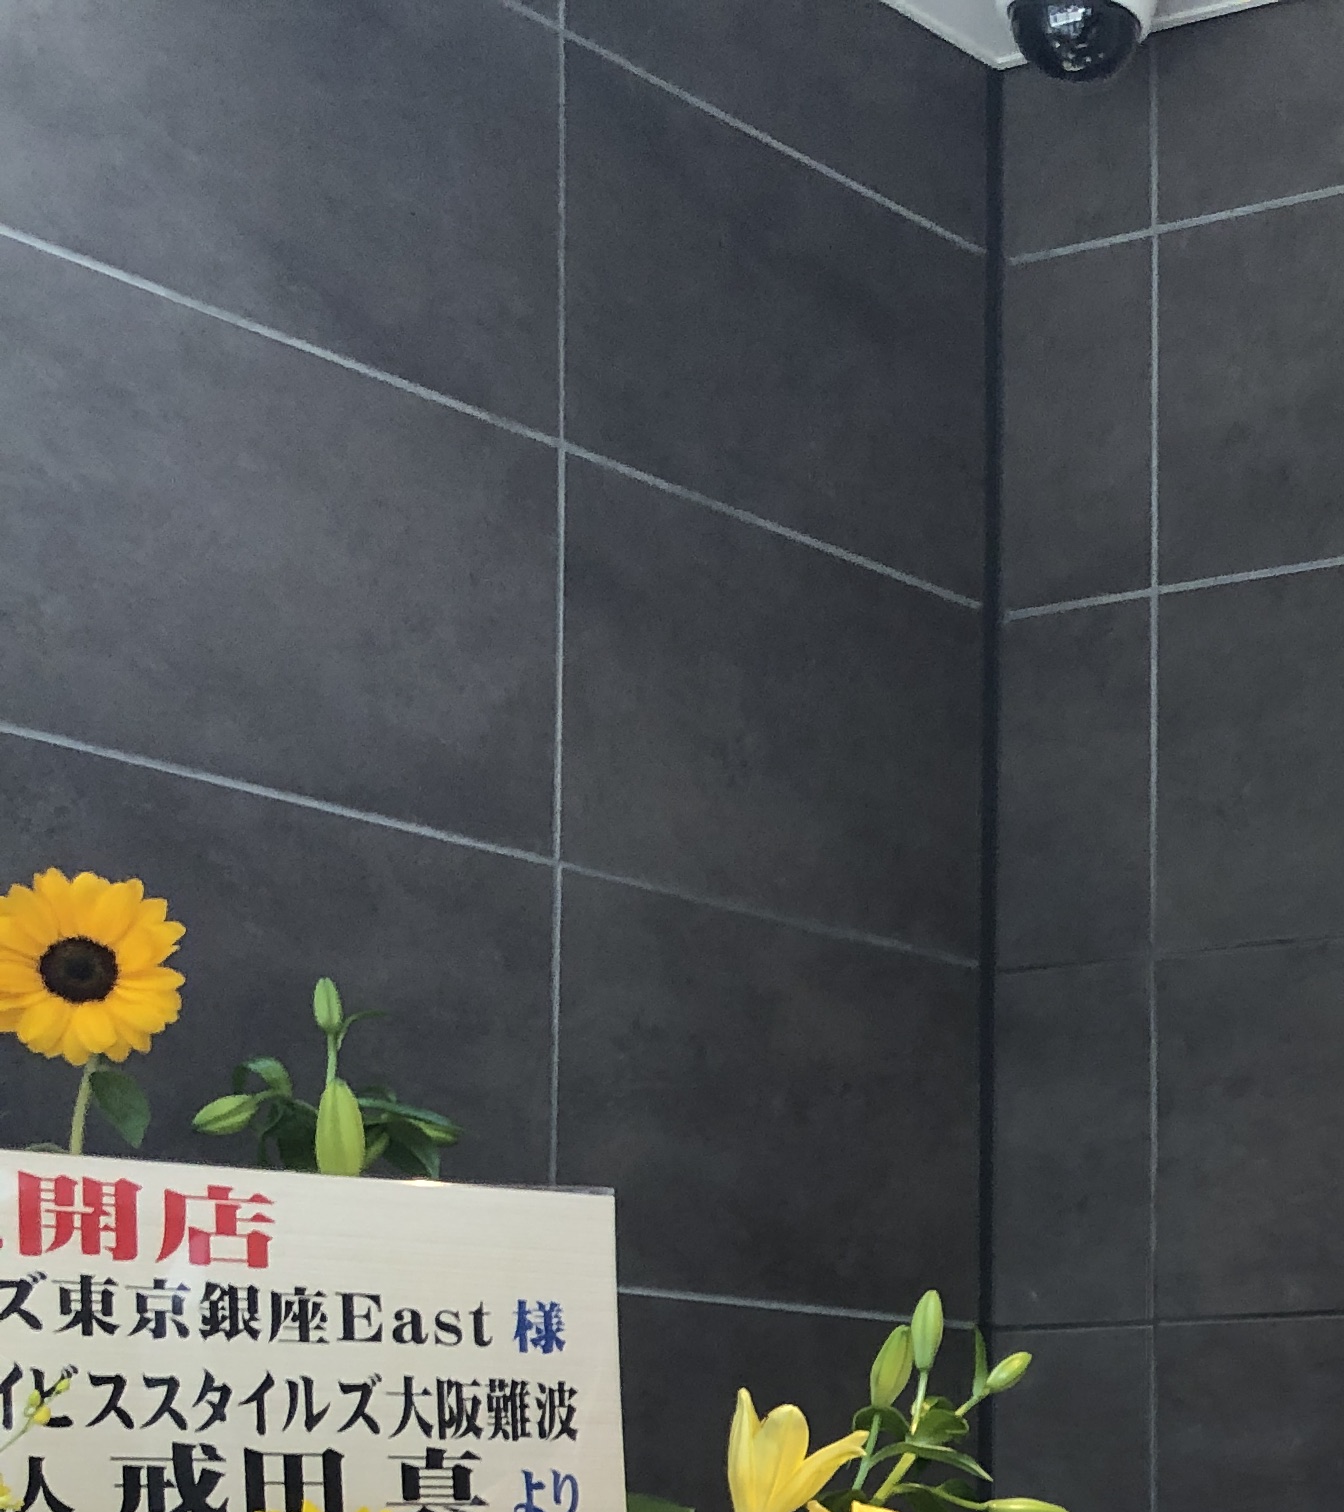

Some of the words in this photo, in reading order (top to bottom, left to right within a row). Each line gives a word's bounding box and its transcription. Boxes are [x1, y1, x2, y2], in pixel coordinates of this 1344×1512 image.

[0, 1170, 275, 1270] 開店
[0, 1271, 494, 1347] ズ東京銀座East
[513, 1299, 566, 1354] 様
